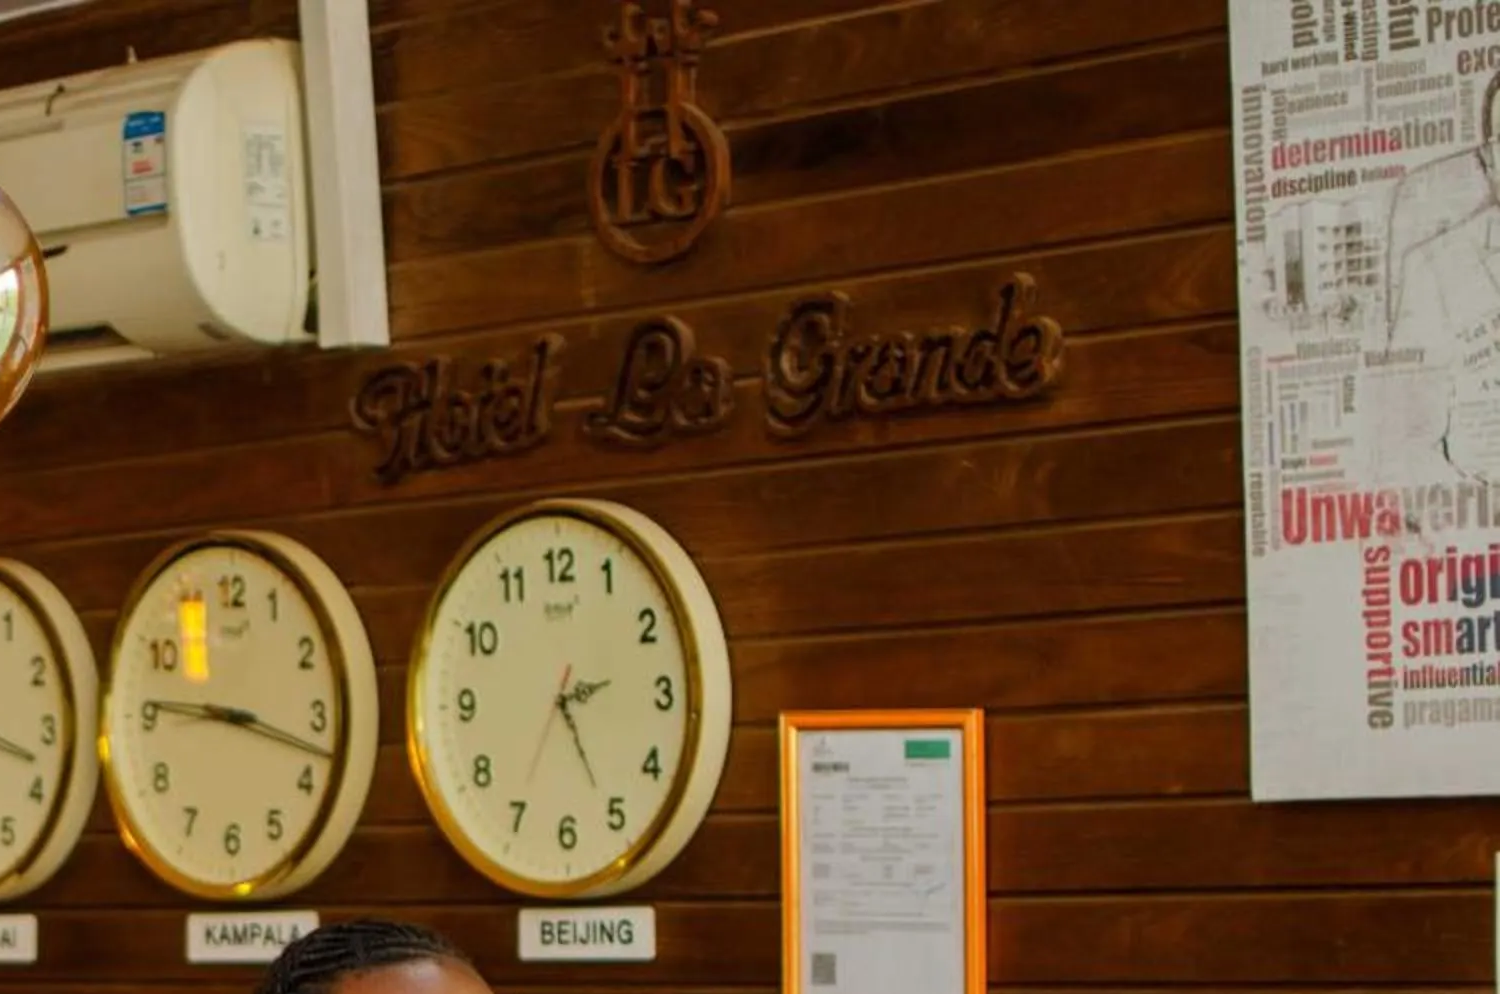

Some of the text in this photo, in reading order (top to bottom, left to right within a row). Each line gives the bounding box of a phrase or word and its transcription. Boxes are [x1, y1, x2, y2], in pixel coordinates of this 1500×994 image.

[1291, 0, 1319, 48] old
[1361, 0, 1378, 62] asting
[1426, 0, 1500, 44] Profe
[1456, 44, 1500, 76] exc
[1271, 117, 1454, 171] determination
[1242, 84, 1267, 243] innovation
[1271, 167, 1357, 199] discipline
[350, 332, 565, 484] Hotel
[764, 271, 1064, 440] Grande
[543, 547, 575, 583] 12
[601, 558, 613, 595] 1
[1400, 544, 1500, 609] origi
[217, 575, 245, 609] 12
[498, 566, 524, 603] 11
[267, 588, 278, 622] 1
[3, 609, 14, 641] 1
[465, 621, 499, 657] 10
[638, 608, 657, 645] 2
[1363, 545, 1394, 730] supportive
[150, 639, 178, 672] 10
[298, 636, 315, 670] 2
[30, 655, 46, 687] 2
[458, 688, 476, 723] 9
[654, 675, 674, 712] 3
[40, 713, 56, 746] 3
[141, 701, 158, 731] 9
[310, 700, 327, 733] 3
[153, 761, 169, 794] 8
[297, 763, 314, 796] 4
[473, 754, 492, 789] 8
[641, 745, 662, 781] 4
[28, 775, 44, 805] 4
[0, 816, 16, 847] 5
[183, 806, 198, 838] 7
[267, 809, 283, 841] 5
[509, 801, 527, 833] 7
[607, 797, 626, 832] 5
[224, 822, 241, 856] 6
[558, 815, 578, 850] 6
[204, 922, 300, 946] KAMPALA
[540, 919, 634, 945] BEIJING
